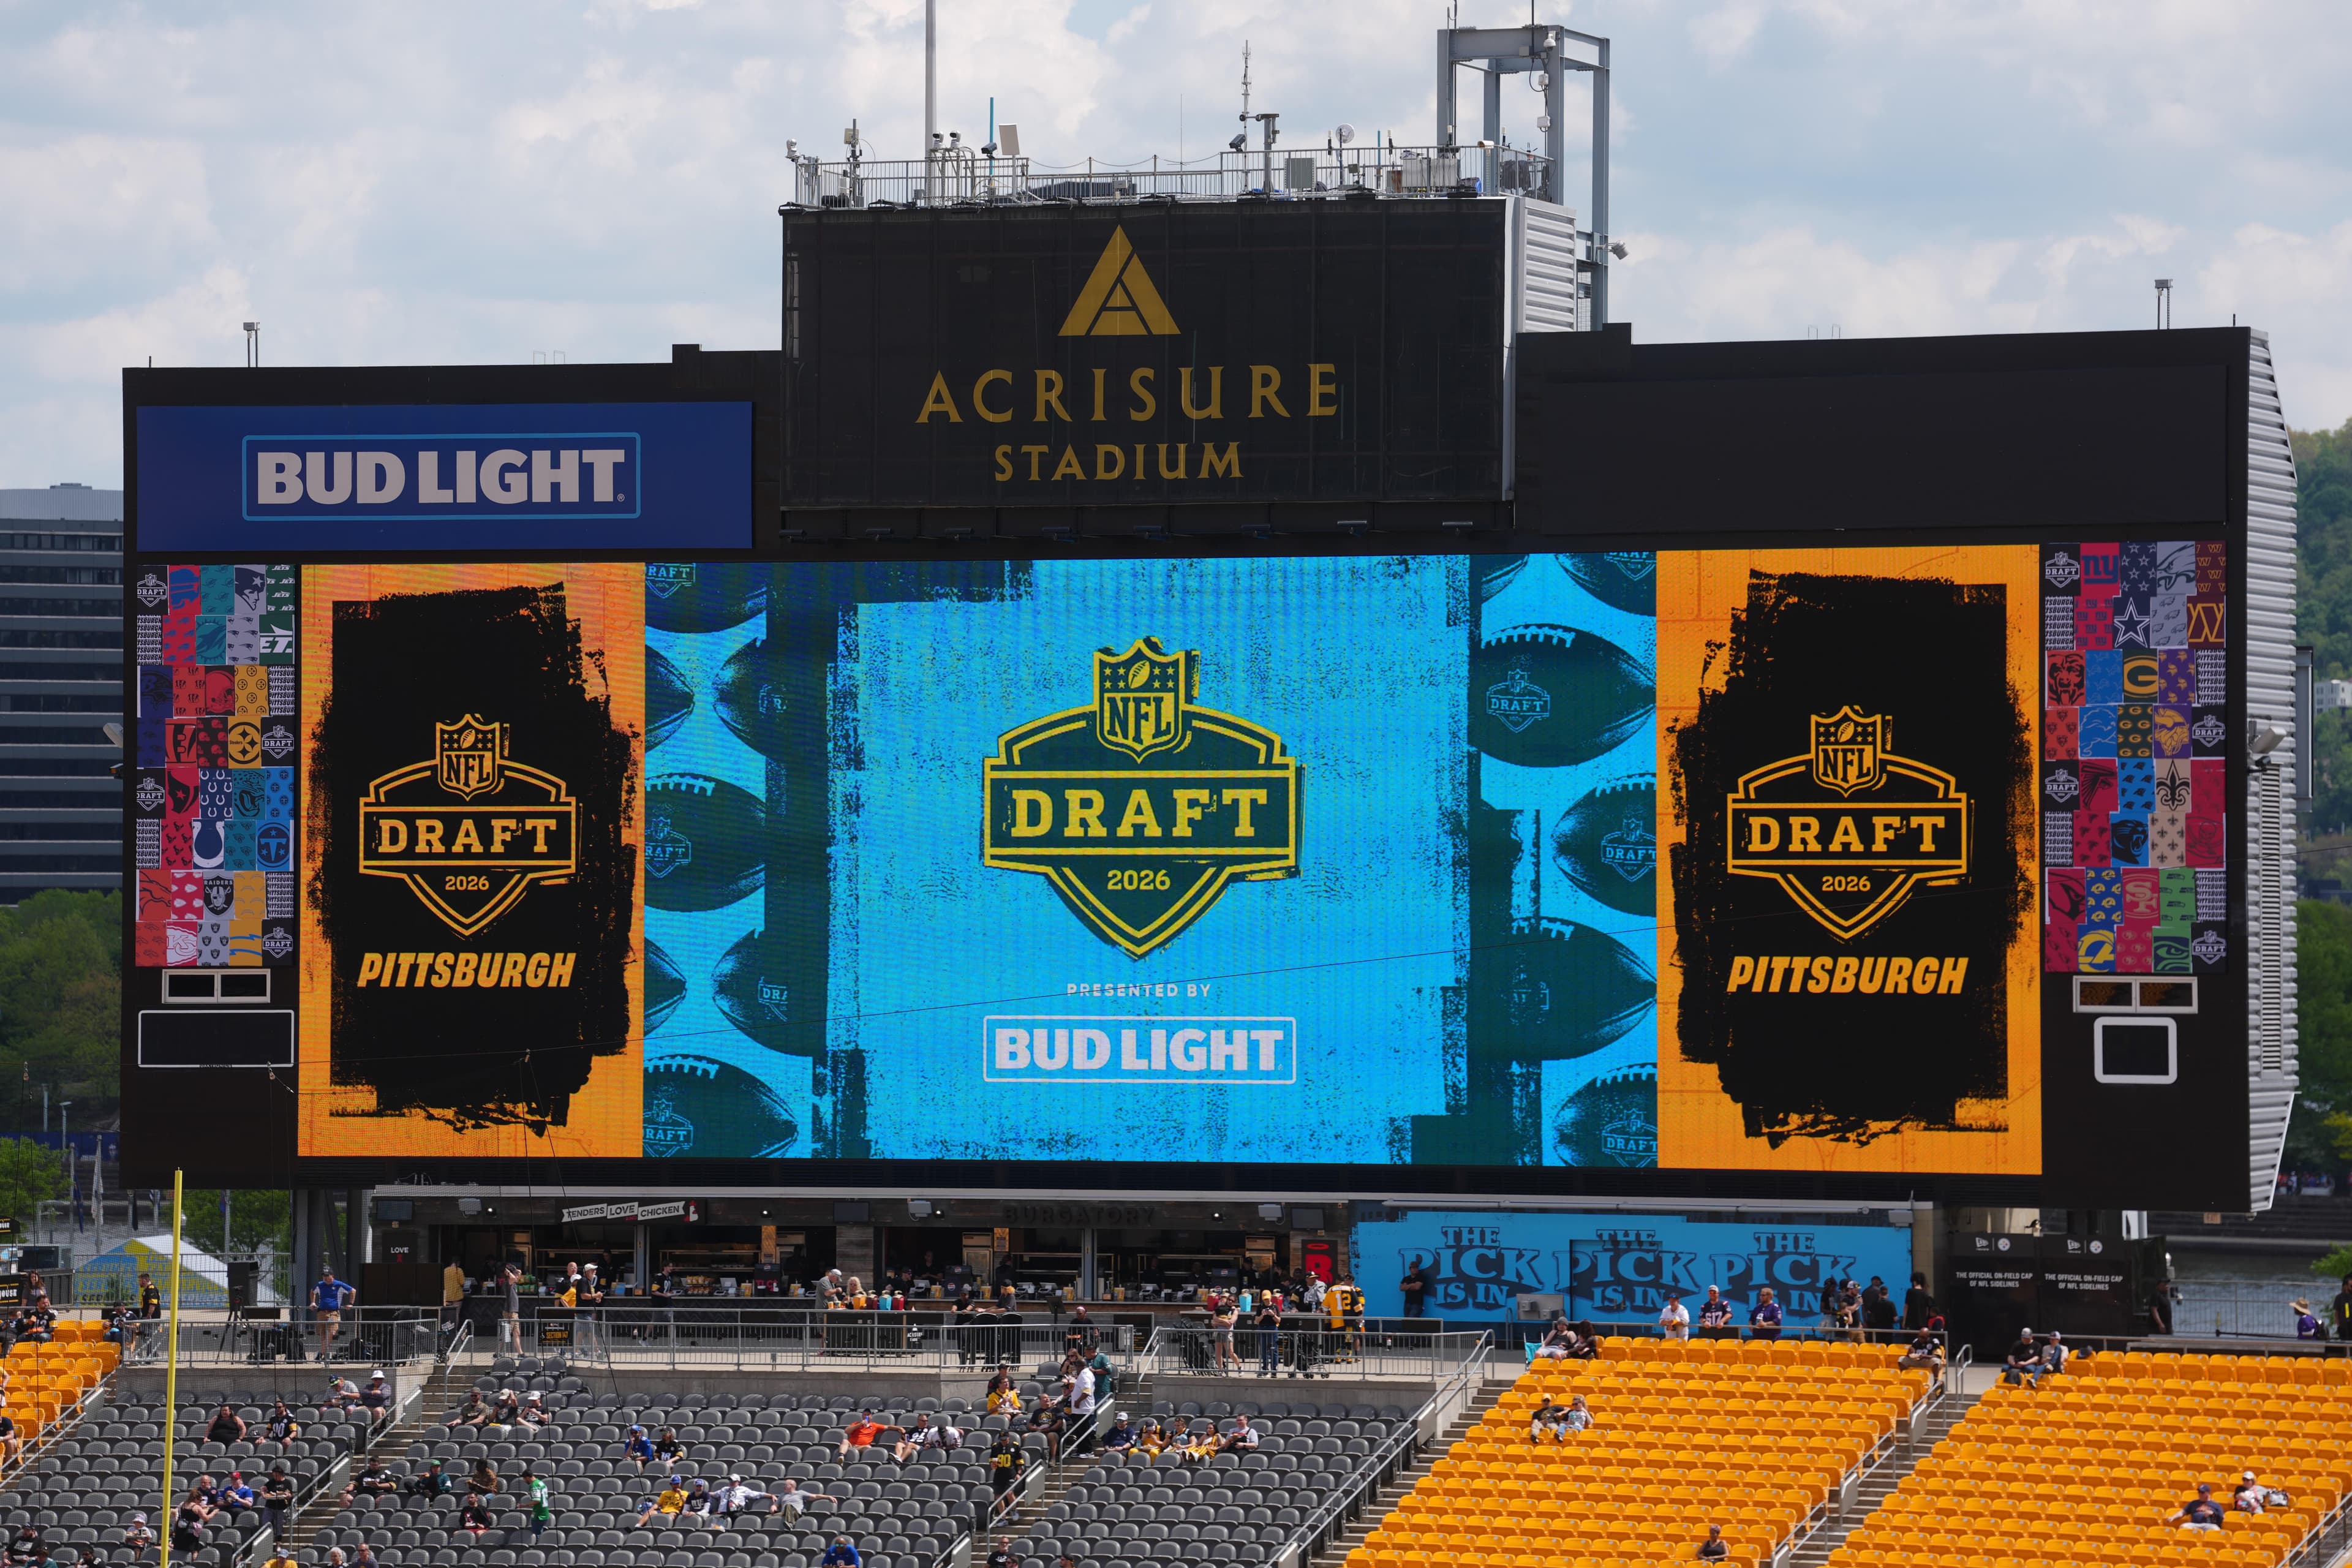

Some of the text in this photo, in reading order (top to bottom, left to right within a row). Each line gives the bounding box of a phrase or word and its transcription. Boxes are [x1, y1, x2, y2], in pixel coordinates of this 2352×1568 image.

[915, 363, 1338, 423] ACRISURE
[995, 442, 1244, 481] STADIUM
[258, 449, 625, 504] BUD LIGHT
[1491, 698, 1544, 711] DRAFT
[1107, 696, 1172, 745] NFL
[445, 754, 490, 787] NFL
[1821, 748, 1871, 782] NFL
[1011, 789, 1267, 837] DRAFT
[379, 819, 556, 853] DRAFT
[1748, 816, 1945, 851] DRAFT
[445, 876, 489, 891] 2026
[1107, 870, 1170, 890] 2026
[1822, 876, 1871, 891] 2026
[357, 952, 576, 987] PITTSBURGH
[1727, 956, 1969, 994] PITTSBURGH
[1067, 984, 1211, 997] PRESENTED BY
[995, 1028, 1284, 1071] BUD LIGHT
[567, 1207, 605, 1218] TENDERS
[609, 1205, 635, 1216] LOVE
[640, 1205, 679, 1217] CHICKEN
[1441, 1226, 1500, 1248] THE
[1596, 1229, 1657, 1250] THE
[1754, 1232, 1814, 1254] THE
[1399, 1248, 1544, 1289] PICK
[1553, 1251, 1700, 1293] PICK
[1435, 1283, 1509, 1306] IS IN
[1593, 1286, 1666, 1308] IS IN
[998, 1454, 1011, 1467] 90
